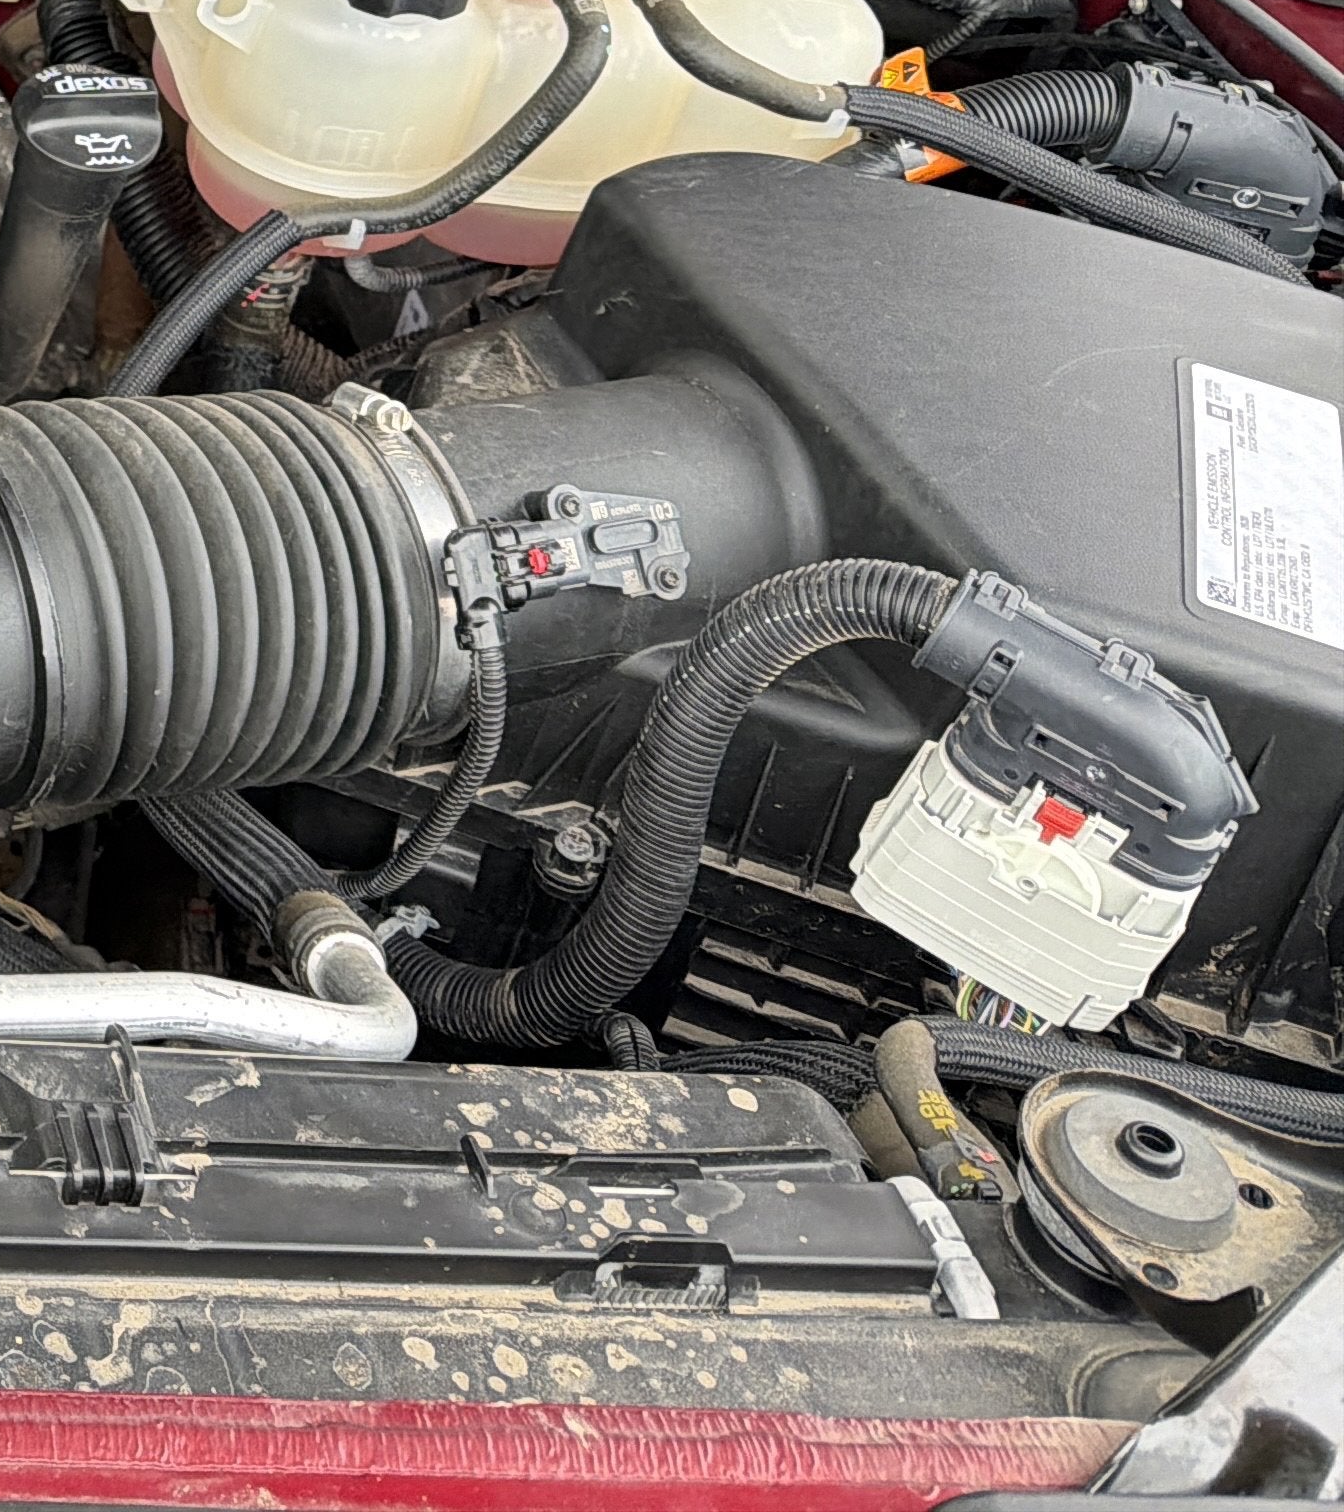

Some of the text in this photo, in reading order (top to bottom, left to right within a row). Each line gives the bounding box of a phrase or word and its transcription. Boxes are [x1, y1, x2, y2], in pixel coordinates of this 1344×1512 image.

[54, 75, 148, 94] dexos
[589, 501, 609, 520] GM
[1205, 451, 1219, 530] VEHICLE EMISSION
[1218, 446, 1232, 547] CONTROL INFORMATION
